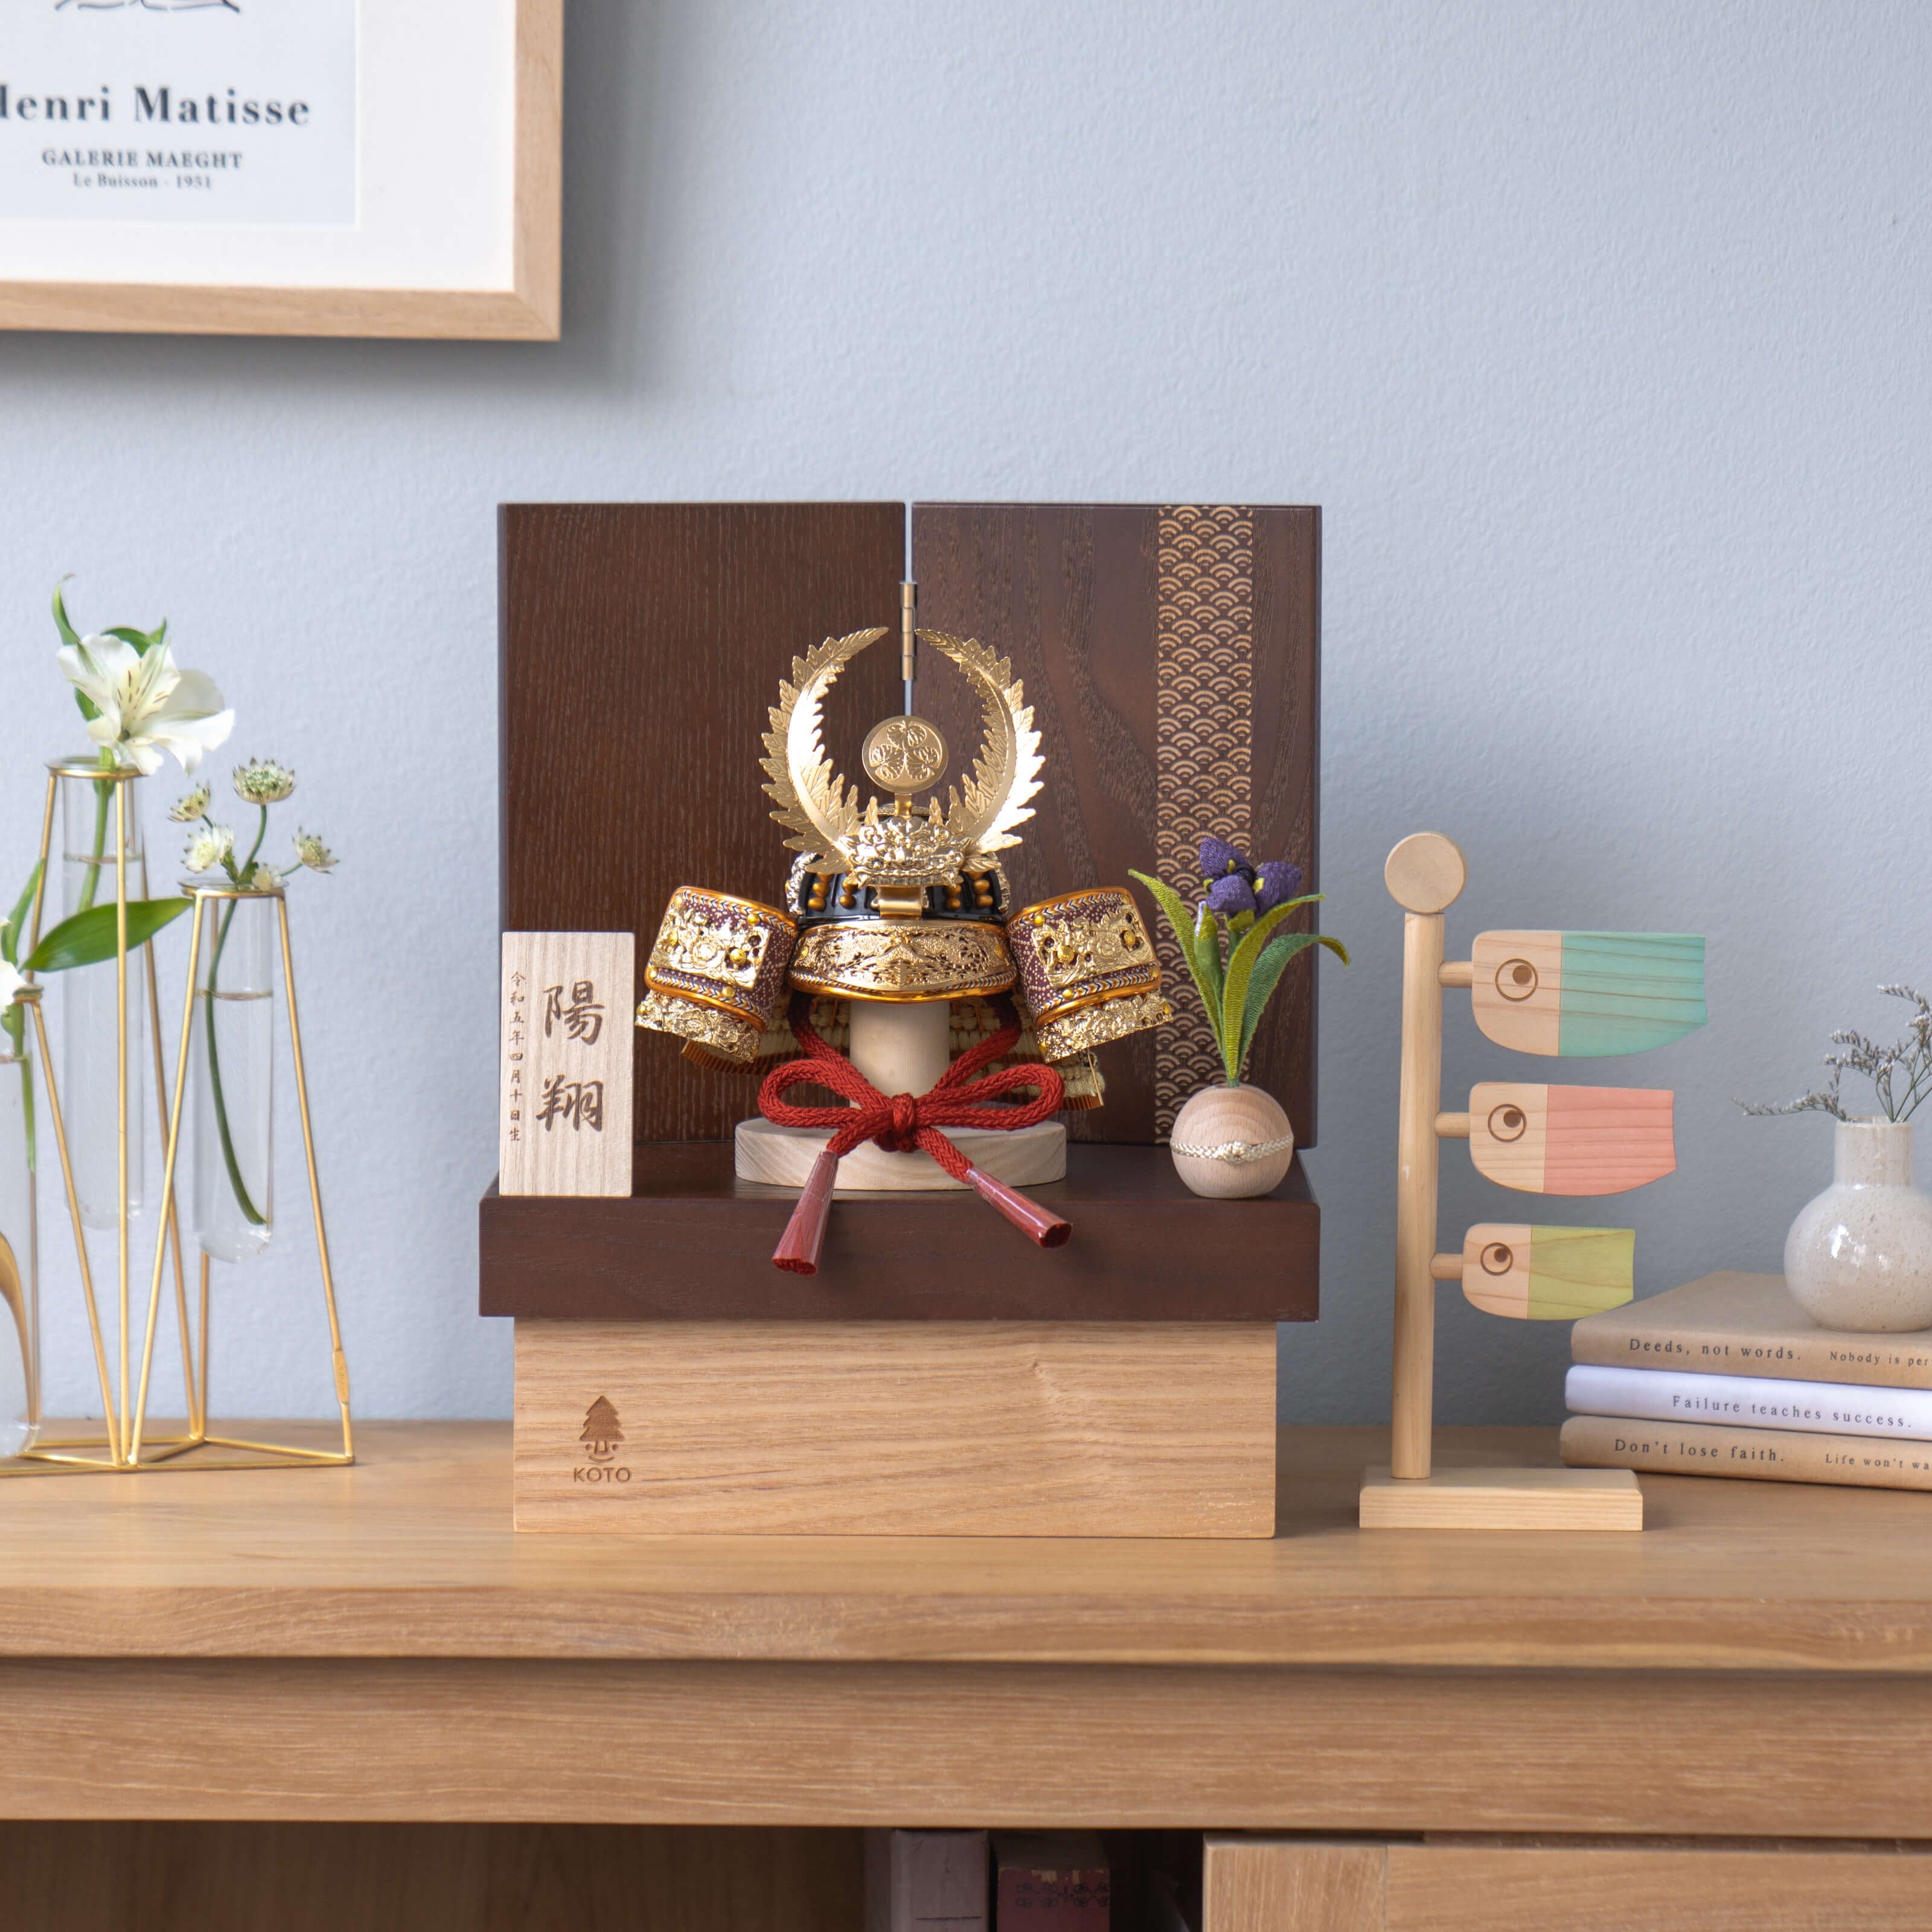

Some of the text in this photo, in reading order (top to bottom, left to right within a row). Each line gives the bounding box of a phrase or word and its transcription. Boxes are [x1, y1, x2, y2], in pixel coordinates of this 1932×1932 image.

[133, 85, 310, 126] Matisse
[42, 149, 243, 169] GALERIE MAEGHT
[73, 173, 92, 187] Le
[97, 173, 159, 188] Buisson
[509, 971, 526, 1142] 令和五年四月十日生
[536, 980, 605, 1132] 陽翔
[1630, 1339, 1801, 1360] Deeds, not words.
[1829, 1351, 1932, 1367] Nobody is per
[1672, 1395, 1912, 1428] Failure teaches success.
[1680, 1443, 1718, 1457] lose
[1730, 1446, 1784, 1462] faith.
[1825, 1454, 1855, 1465] Life
[1863, 1458, 1903, 1468] won't
[574, 1467, 631, 1483] KOTO
